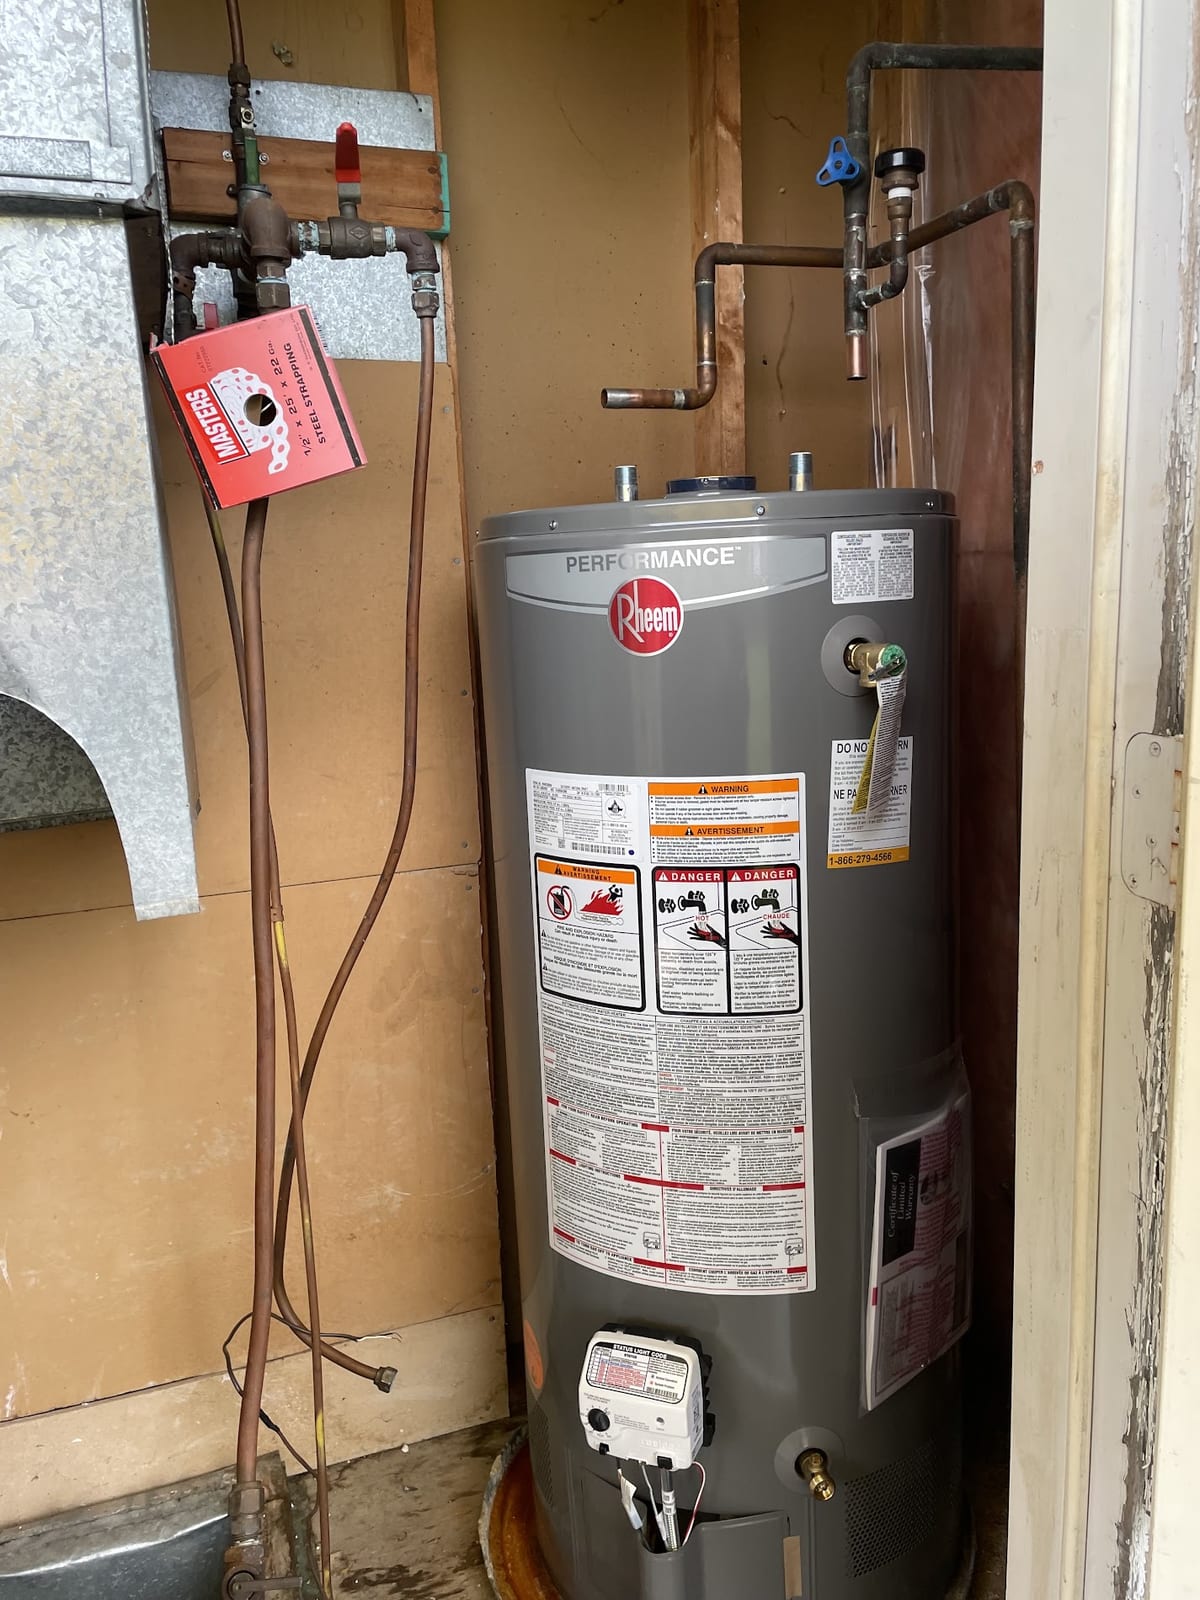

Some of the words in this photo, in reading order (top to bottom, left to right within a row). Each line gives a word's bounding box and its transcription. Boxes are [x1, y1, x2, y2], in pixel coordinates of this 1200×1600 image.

[270, 357, 283, 376] 22
[283, 342, 313, 408] STRAPPING
[185, 388, 239, 458] MASTERS
[309, 409, 327, 444] STEEL
[616, 581, 679, 643] Rheem
[836, 743, 851, 754] DO
[854, 742, 870, 753] NO
[711, 785, 749, 793] WARNING
[833, 789, 845, 800] NE
[697, 826, 765, 835] AVERTISSEMENT
[563, 871, 612, 881] AVERTISSEMENT
[572, 866, 600, 875] WARNING
[671, 873, 721, 881] DANGER
[744, 870, 794, 880] DANGER
[897, 1182, 906, 1220] Limited
[905, 1175, 916, 1220] Warranty
[887, 1184, 897, 1238] Certificate
[613, 1343, 634, 1353] STATUS
[633, 1348, 651, 1356] LIGHT
[650, 1351, 668, 1360] CODE
